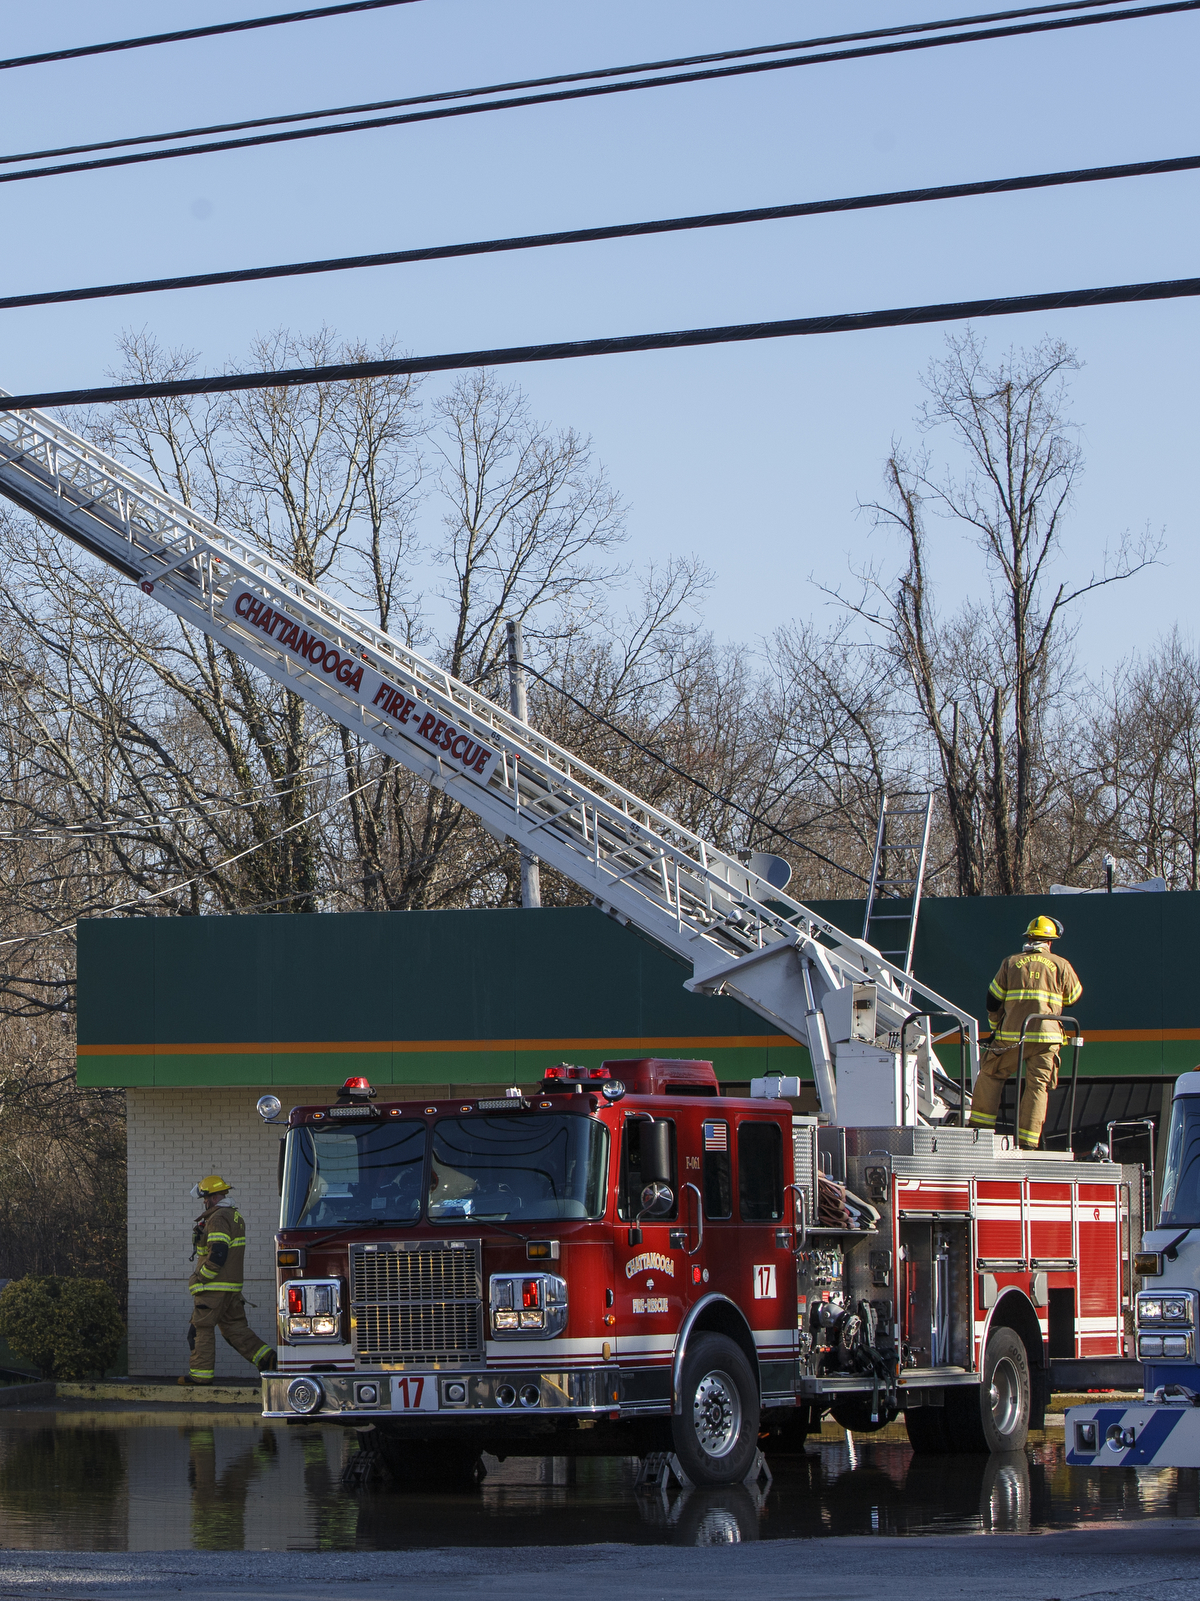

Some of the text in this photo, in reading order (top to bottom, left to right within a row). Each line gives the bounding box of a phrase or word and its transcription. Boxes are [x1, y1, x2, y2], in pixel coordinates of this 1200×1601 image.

[234, 592, 493, 775] CHATTANOOGA FIRE-RESCUE
[490, 731, 501, 741] 65
[630, 822, 641, 833] 55
[772, 918, 784, 928] 45
[822, 924, 834, 934] 45
[625, 1252, 675, 1279] CHATTANOOGA
[757, 1267, 771, 1296] 17
[398, 1377, 425, 1408] 17
